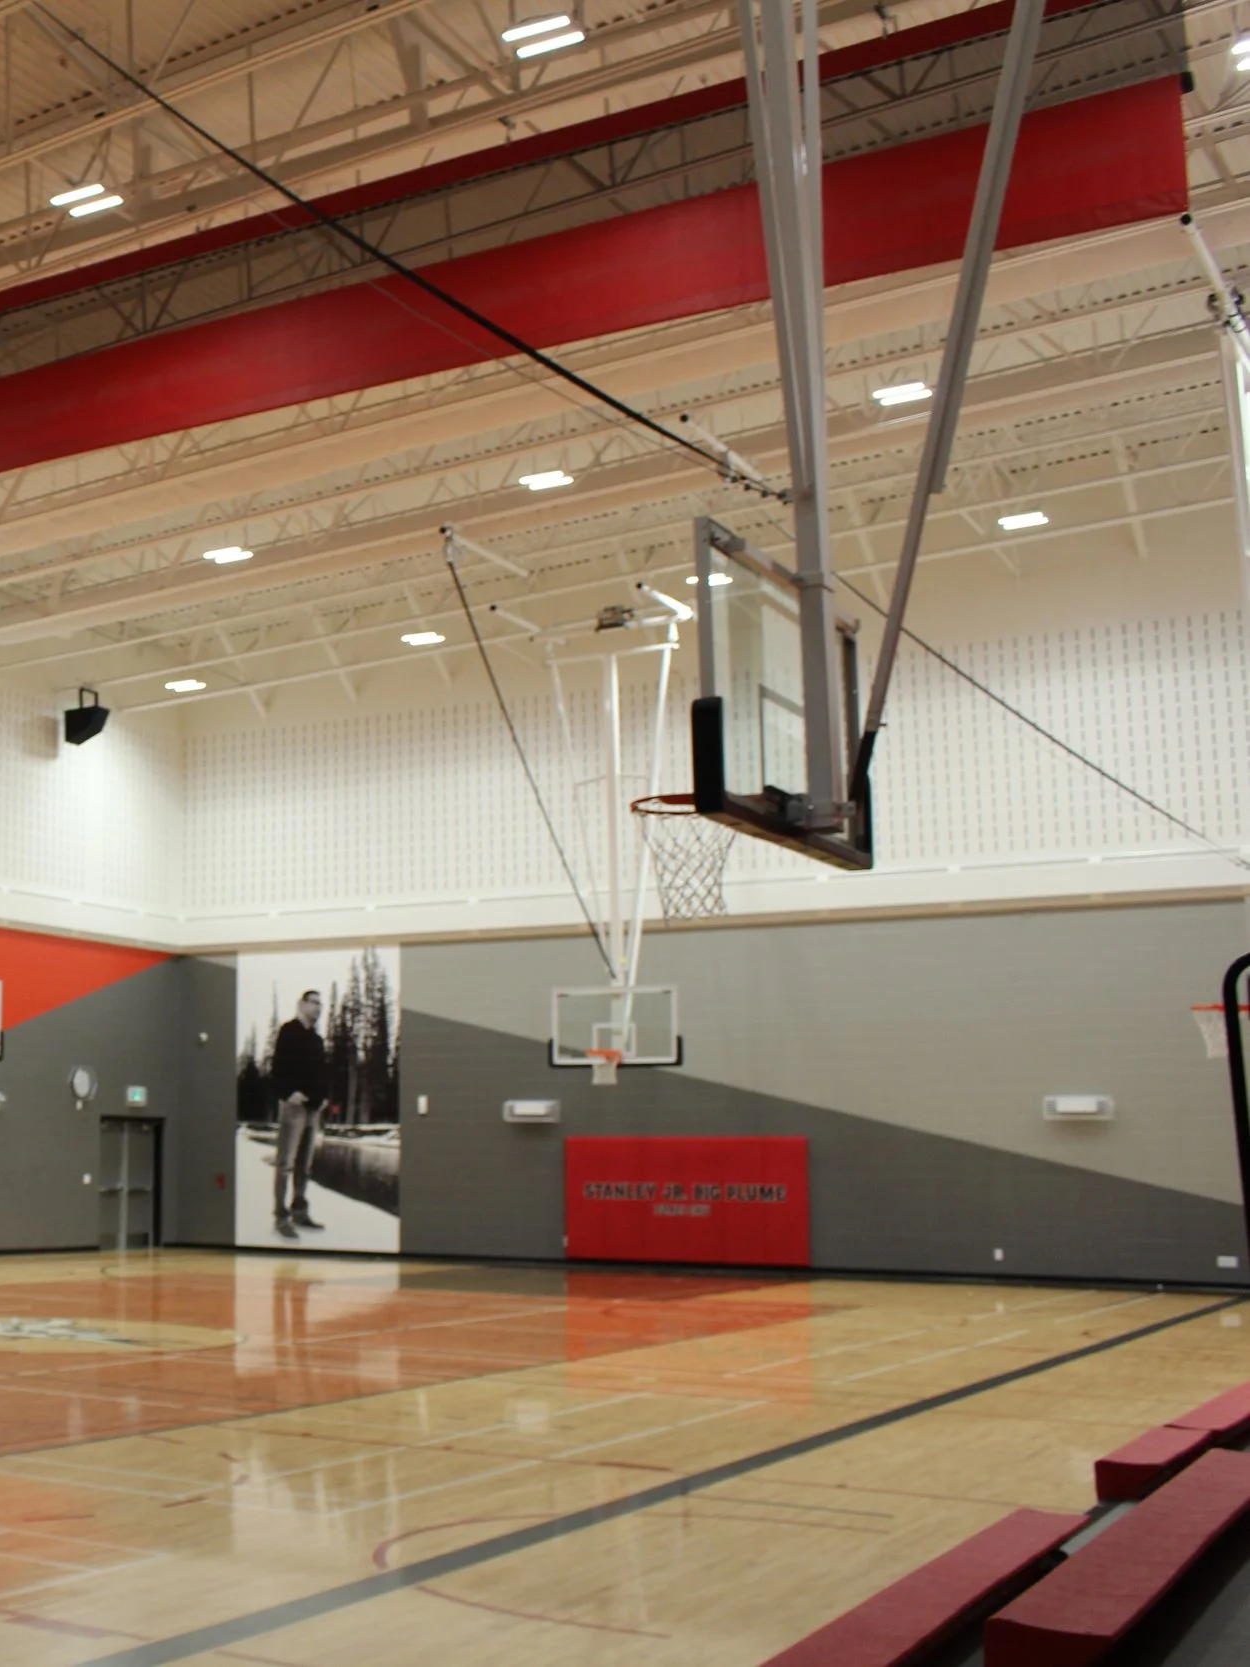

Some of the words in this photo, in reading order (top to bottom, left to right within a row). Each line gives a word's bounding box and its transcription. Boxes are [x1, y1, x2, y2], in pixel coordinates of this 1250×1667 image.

[584, 1182, 656, 1200] STANLEY
[694, 1184, 721, 1201] BIG
[725, 1185, 787, 1202] PLUME
